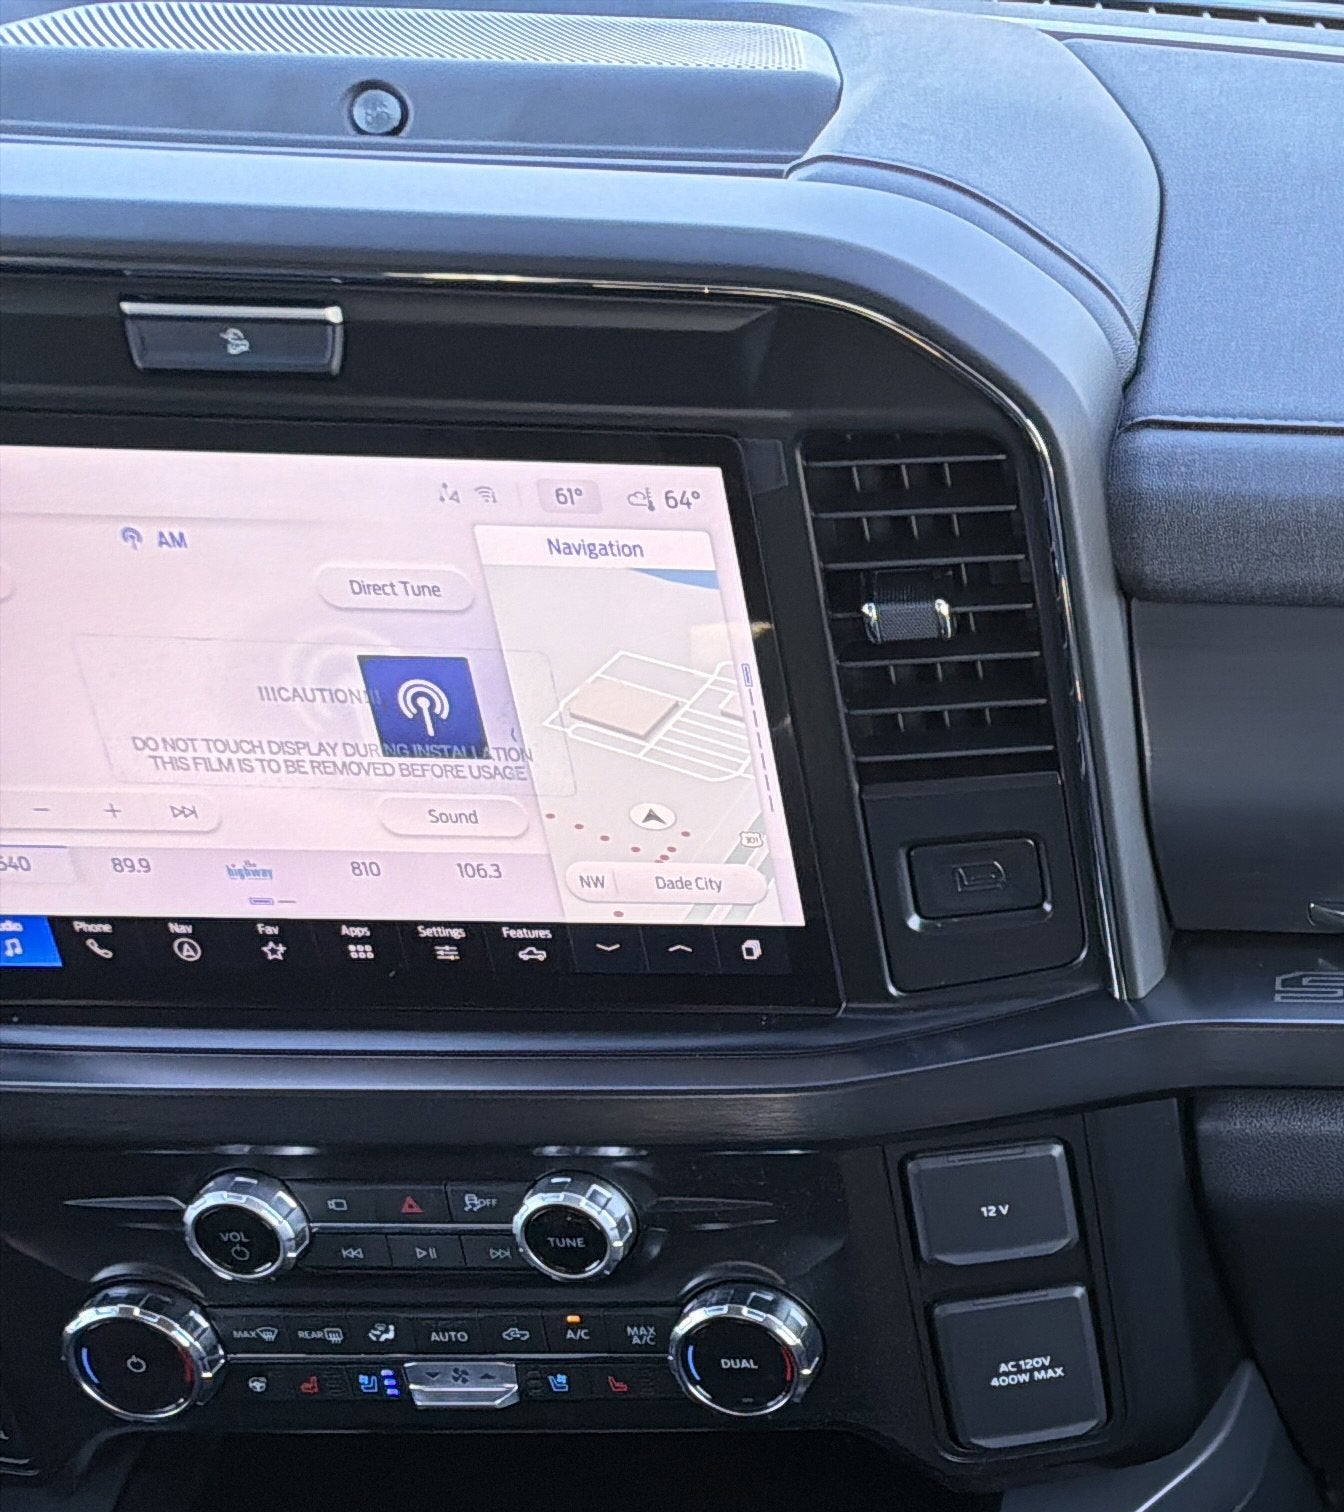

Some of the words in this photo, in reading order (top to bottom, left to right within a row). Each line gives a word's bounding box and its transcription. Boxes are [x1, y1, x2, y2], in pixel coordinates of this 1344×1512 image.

[158, 531, 187, 549] AM
[547, 538, 645, 559] Navigation
[349, 579, 398, 597] Direct
[399, 580, 441, 598] Tune
[131, 736, 160, 752] DO
[161, 737, 200, 754] NOT
[200, 738, 264, 755] TOUCH
[267, 740, 339, 758] DISPLAY
[148, 756, 190, 771] THIS
[191, 757, 236, 773] FILM
[239, 758, 255, 773] IS
[255, 758, 282, 774] TO
[284, 759, 309, 775] BE
[310, 760, 396, 777] REMOVED
[399, 763, 468, 780] BEFORE
[468, 766, 528, 781] USAGE
[428, 808, 479, 826] Sound
[110, 856, 153, 874] 89.9
[350, 861, 382, 877] 810
[456, 862, 503, 879] 106.3
[579, 875, 606, 889] NW
[655, 875, 692, 890] Dade
[695, 876, 722, 893] City
[73, 921, 113, 933] Phone
[168, 922, 193, 935] Nav
[256, 924, 280, 936] Fav
[340, 924, 371, 938] Apps
[417, 925, 467, 940] Settings
[502, 926, 553, 939] Features
[478, 1198, 498, 1208] OFF
[980, 1205, 997, 1218] 12
[998, 1203, 1010, 1216] V
[219, 1231, 251, 1244] VOL
[547, 1236, 586, 1249] TUNE
[232, 1329, 257, 1339] MAX
[297, 1329, 325, 1340] REAR
[430, 1330, 469, 1343] AUTO
[566, 1328, 591, 1341] A/C
[627, 1326, 656, 1336] MAX
[632, 1335, 657, 1346] A/C
[720, 1357, 759, 1370] DUAL
[998, 1361, 1018, 1374] AC
[1018, 1355, 1051, 1370] 120V
[990, 1372, 1031, 1387] 400W
[1033, 1366, 1065, 1381] MAX
